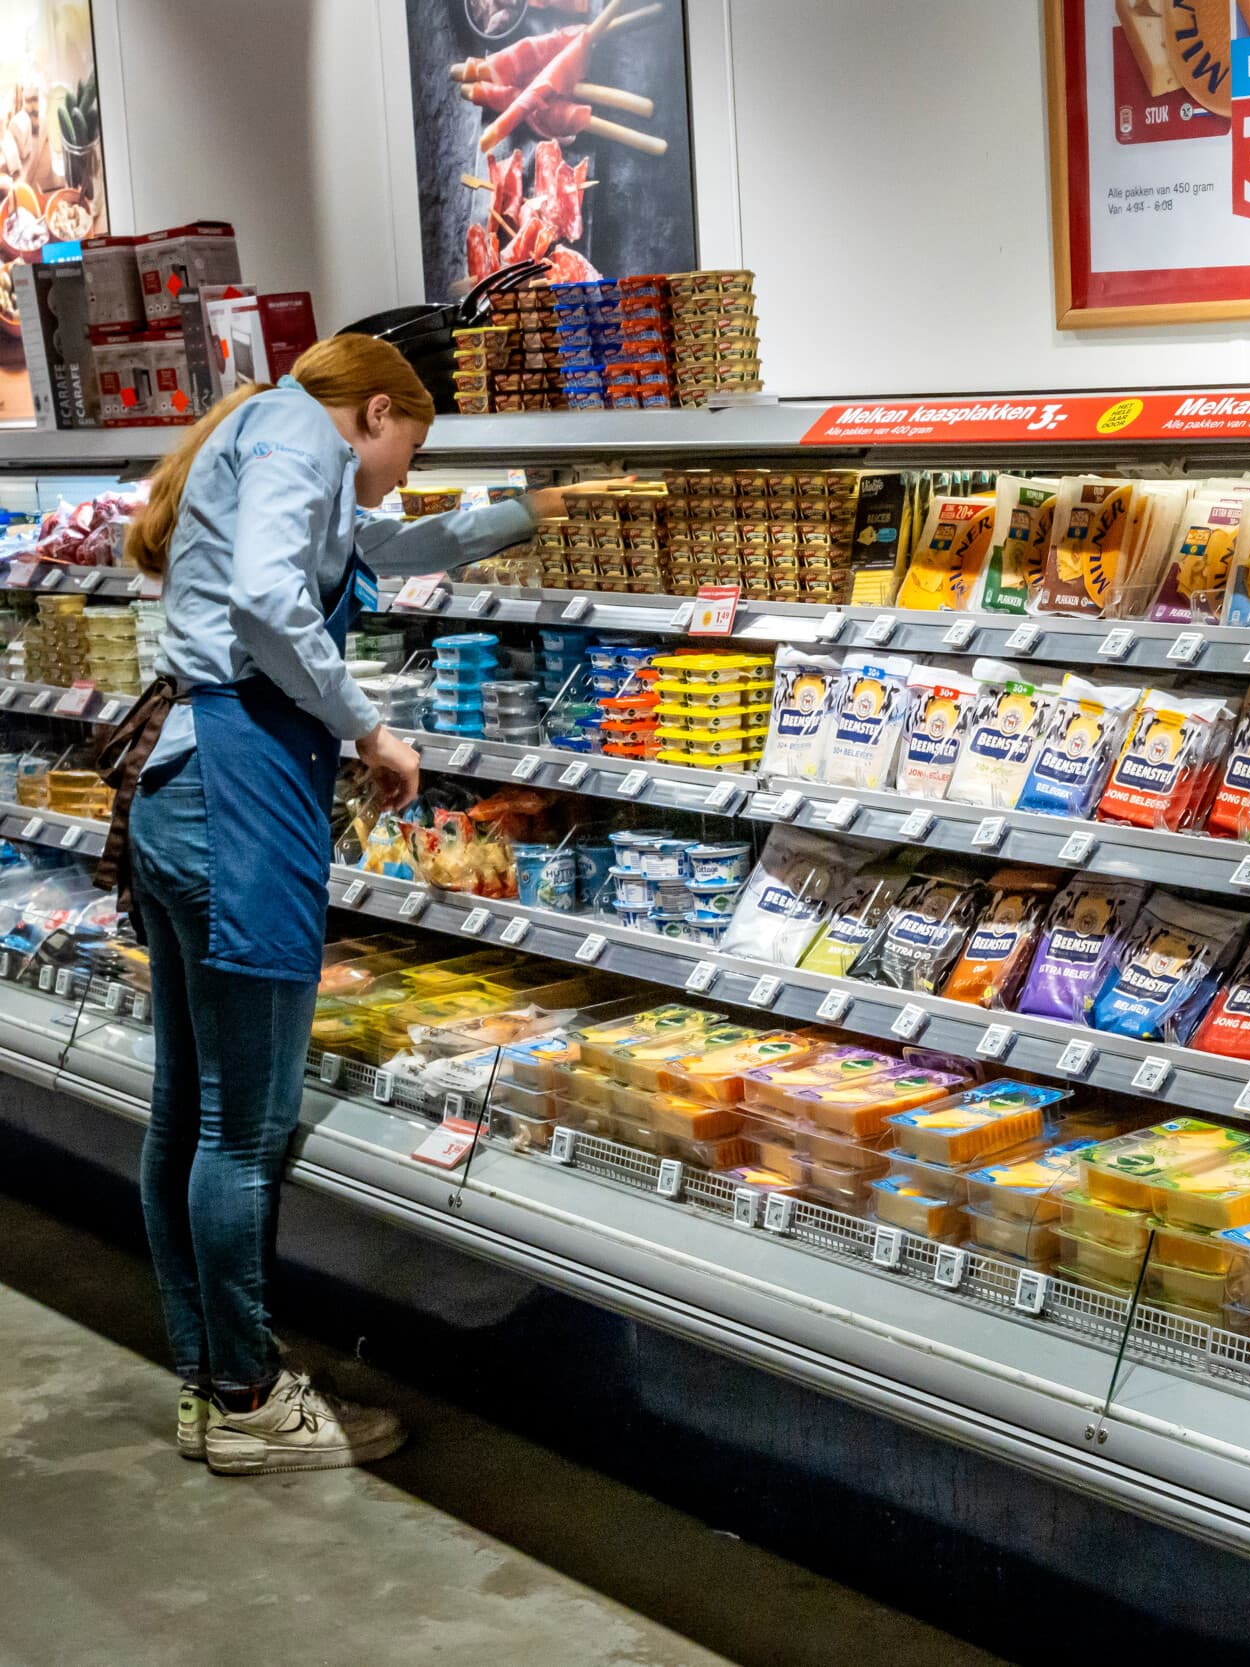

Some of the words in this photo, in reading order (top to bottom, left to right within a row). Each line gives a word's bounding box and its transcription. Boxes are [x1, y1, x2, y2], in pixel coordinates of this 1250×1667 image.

[1145, 105, 1169, 124] STUK
[1107, 188, 1123, 198] Alle
[1125, 187, 1154, 201] pakken
[1156, 187, 1171, 195] van
[1173, 182, 1190, 194] 450
[1193, 182, 1214, 196] gram
[1108, 203, 1123, 214] Van
[70, 362, 85, 418] CARAFE
[836, 406, 908, 424] Melkan
[909, 403, 1038, 426] kaasplakken
[824, 426, 842, 436] Alle
[842, 427, 873, 437] pakken
[874, 427, 889, 435] van
[890, 425, 909, 434] 400
[909, 427, 934, 437] gram
[1101, 420, 1127, 429] DOOR
[1162, 418, 1185, 429] Alle
[1185, 418, 1225, 431] pakken
[1226, 419, 1247, 428] van
[955, 505, 974, 519] 20+
[1089, 499, 1125, 595] MILNER
[868, 668, 881, 677] 30+
[938, 688, 953, 698] 30+
[1041, 752, 1090, 777] BEEMSTER
[1105, 790, 1130, 801] JONG
[1131, 795, 1170, 810] BELEGEN
[1217, 791, 1240, 803] JONG
[884, 941, 910, 957] EXTRA
[1213, 1016, 1239, 1029] JONG
